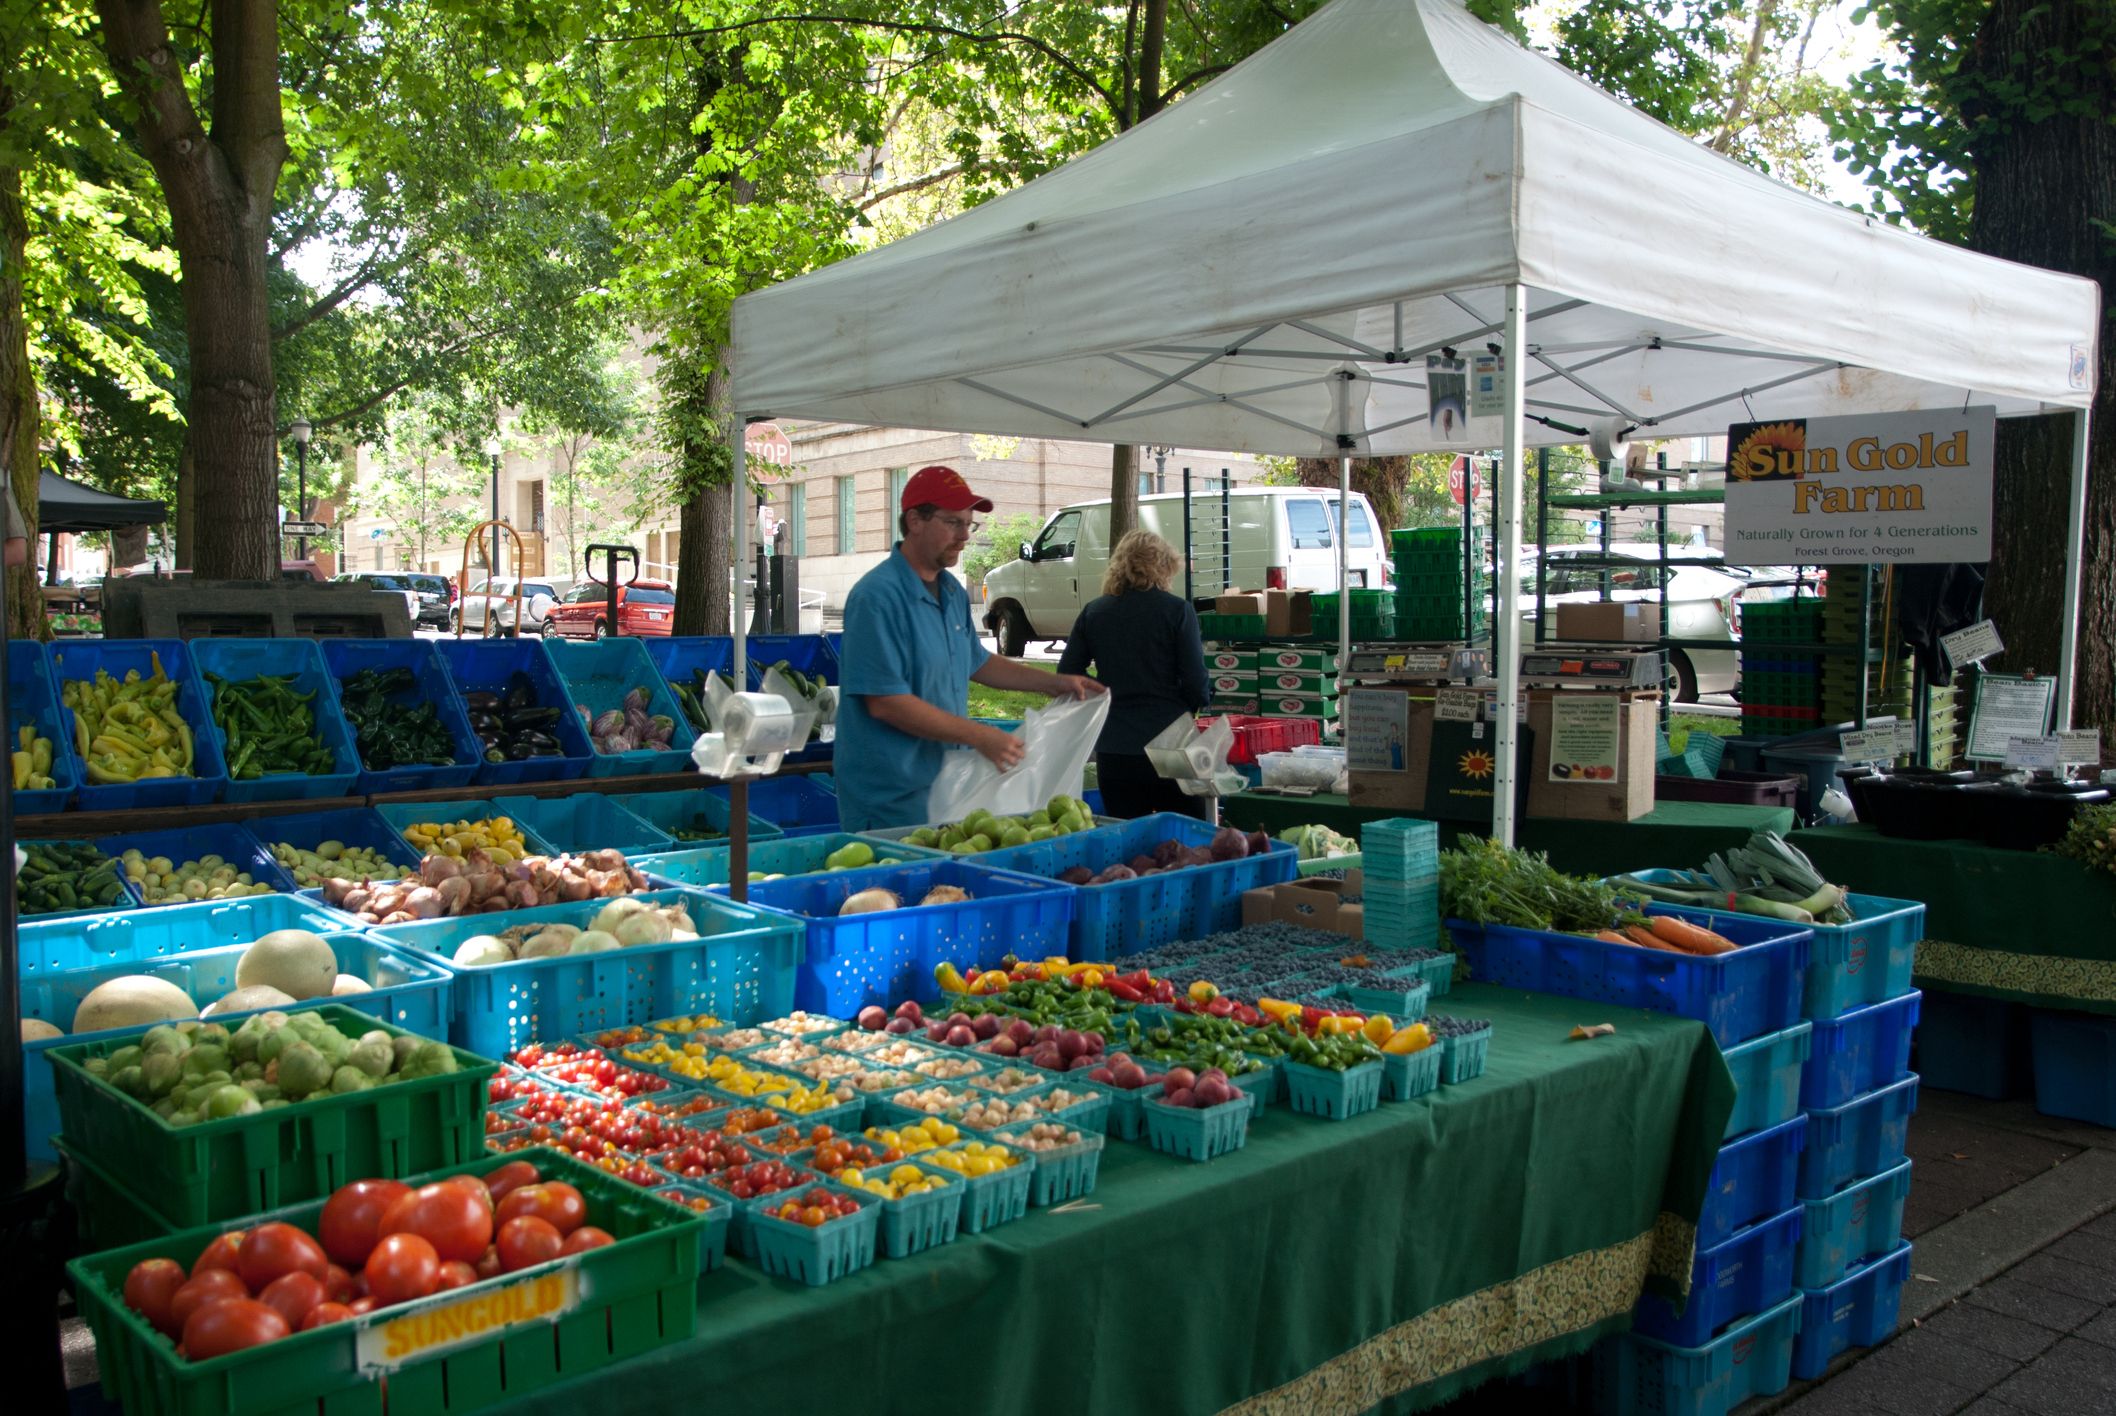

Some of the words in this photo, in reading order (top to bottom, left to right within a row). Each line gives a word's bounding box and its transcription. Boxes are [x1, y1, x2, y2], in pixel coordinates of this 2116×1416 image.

[1747, 443, 1839, 477] Sun
[1846, 430, 1969, 471] Gold
[1451, 470, 1479, 489] STP
[1793, 480, 1925, 514] Farm
[1737, 528, 1793, 543] Naturally
[1800, 528, 1844, 539] Grown
[1849, 527, 1868, 538] for
[1873, 526, 1883, 537] 4
[1888, 524, 1978, 537] Generations
[1795, 547, 1827, 556] Forest
[1832, 547, 1868, 557] Grove,
[1872, 546, 1915, 557] Oregon
[1944, 635, 1962, 645] Dry
[1963, 624, 1989, 637] Beans
[384, 1273, 564, 1358] SUNGOLD
